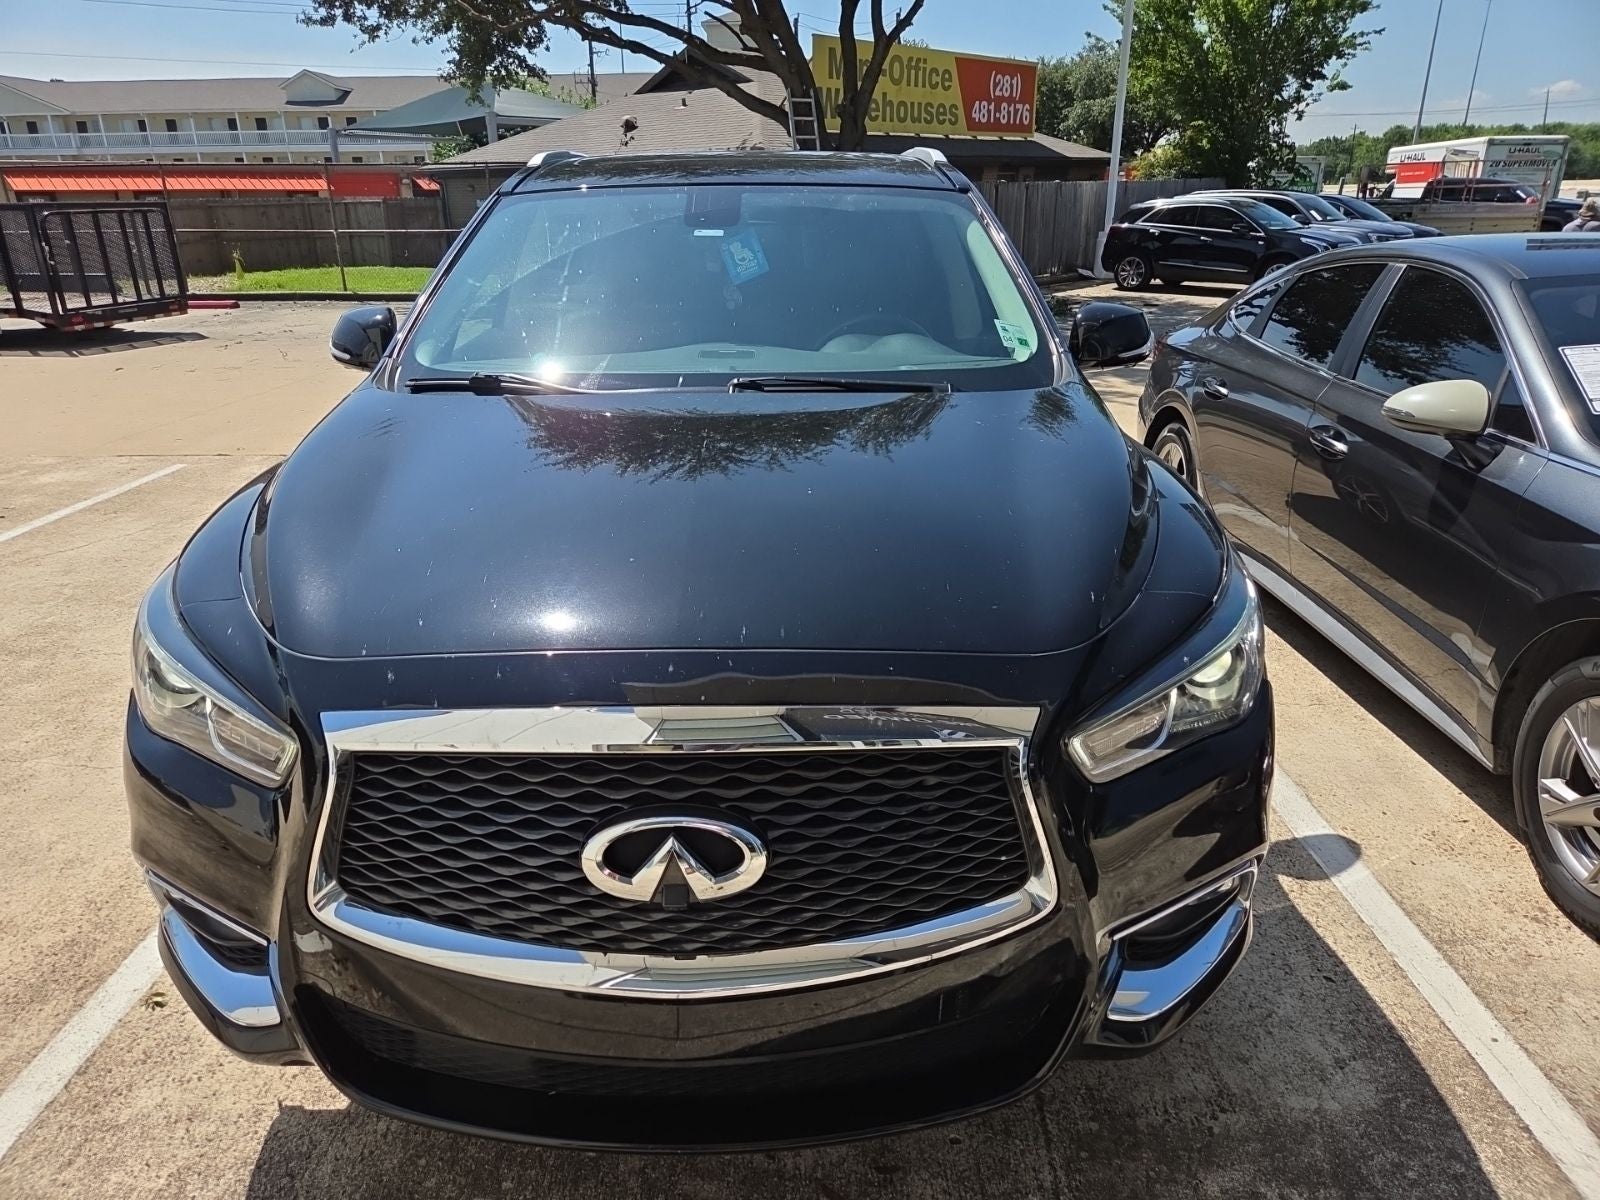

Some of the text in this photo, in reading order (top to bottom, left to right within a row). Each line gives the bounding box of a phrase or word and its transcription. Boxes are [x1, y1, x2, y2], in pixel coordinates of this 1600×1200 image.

[828, 46, 953, 92] Mn-Office
[990, 70, 1022, 101] (281)
[815, 86, 959, 126] Wehouses
[971, 101, 1030, 125] 481-8176
